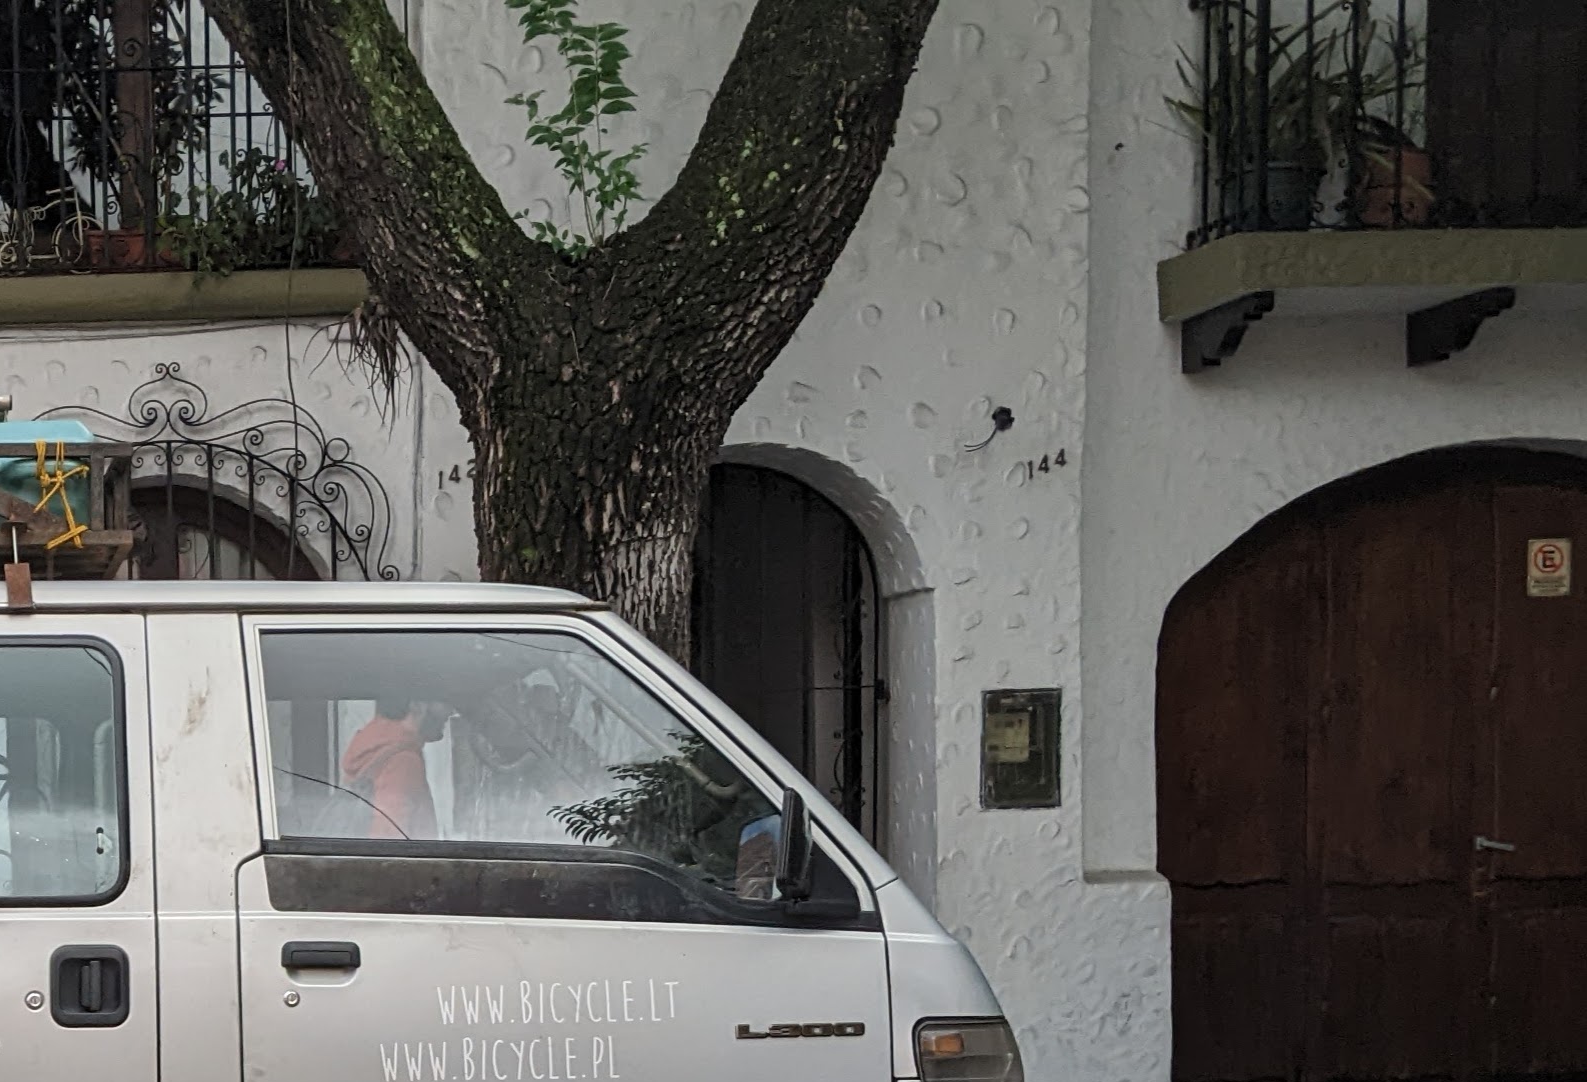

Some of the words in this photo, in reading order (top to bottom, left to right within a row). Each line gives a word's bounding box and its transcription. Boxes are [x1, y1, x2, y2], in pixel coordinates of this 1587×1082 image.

[1027, 448, 1067, 480] 144
[1542, 550, 1556, 569] E
[436, 978, 679, 1025] WWW.BICYCLE.LT
[734, 1021, 866, 1040] L300
[379, 1035, 620, 1082] WWW.BICYCLE.PL
